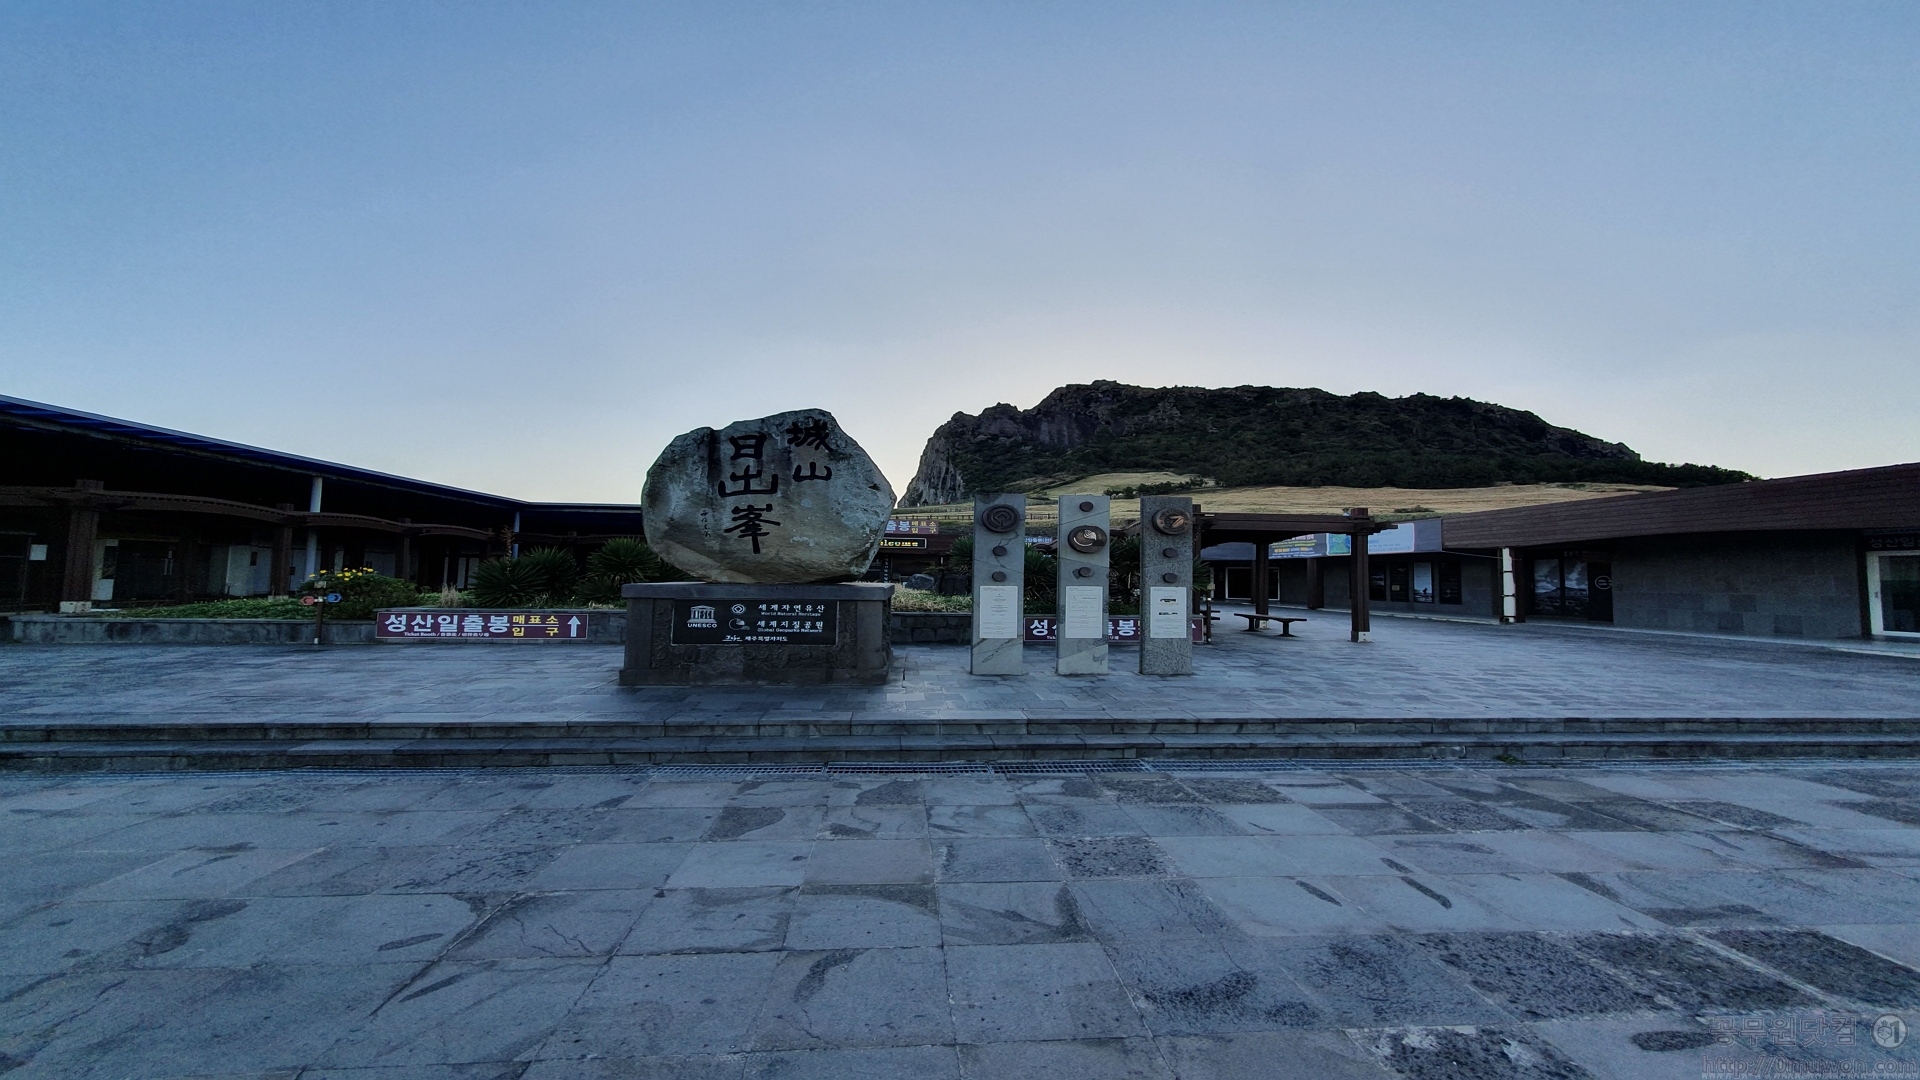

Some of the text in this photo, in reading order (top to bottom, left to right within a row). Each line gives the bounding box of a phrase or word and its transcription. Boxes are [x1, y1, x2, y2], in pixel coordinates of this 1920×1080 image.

[757, 603, 825, 613] 세계자연유산
[384, 614, 511, 633] 성산일출봉
[512, 615, 559, 625] 매표소
[756, 620, 824, 629] 세계지질공원
